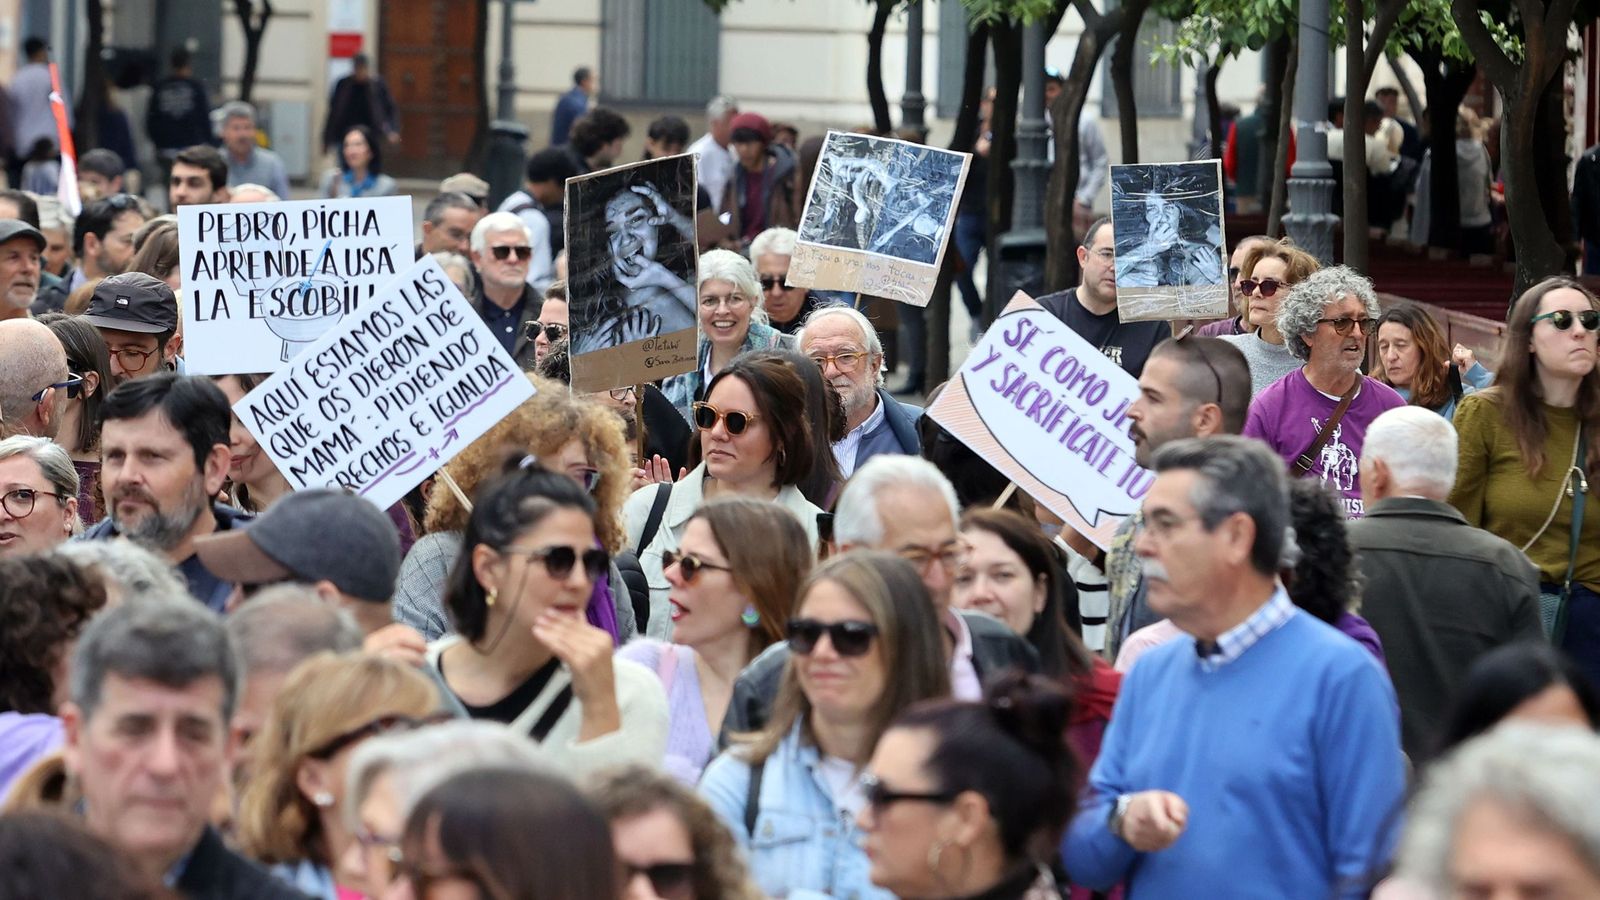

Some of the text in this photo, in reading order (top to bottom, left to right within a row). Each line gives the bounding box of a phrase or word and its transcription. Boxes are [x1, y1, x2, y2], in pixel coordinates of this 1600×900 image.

[198, 204, 381, 246] PEDRO, PICHA
[191, 249, 314, 281] APRENDE
[320, 250, 339, 277] A
[193, 287, 231, 322] LA
[249, 268, 445, 435] AQUÍ ESTAMOS LAS
[971, 344, 1002, 373] Y
[1002, 317, 1055, 357] SÉ
[1039, 345, 1110, 407] COMO
[270, 299, 463, 459] QUE OS DIERON DE
[373, 328, 479, 421] PIDIENDO
[408, 412, 432, 437] E
